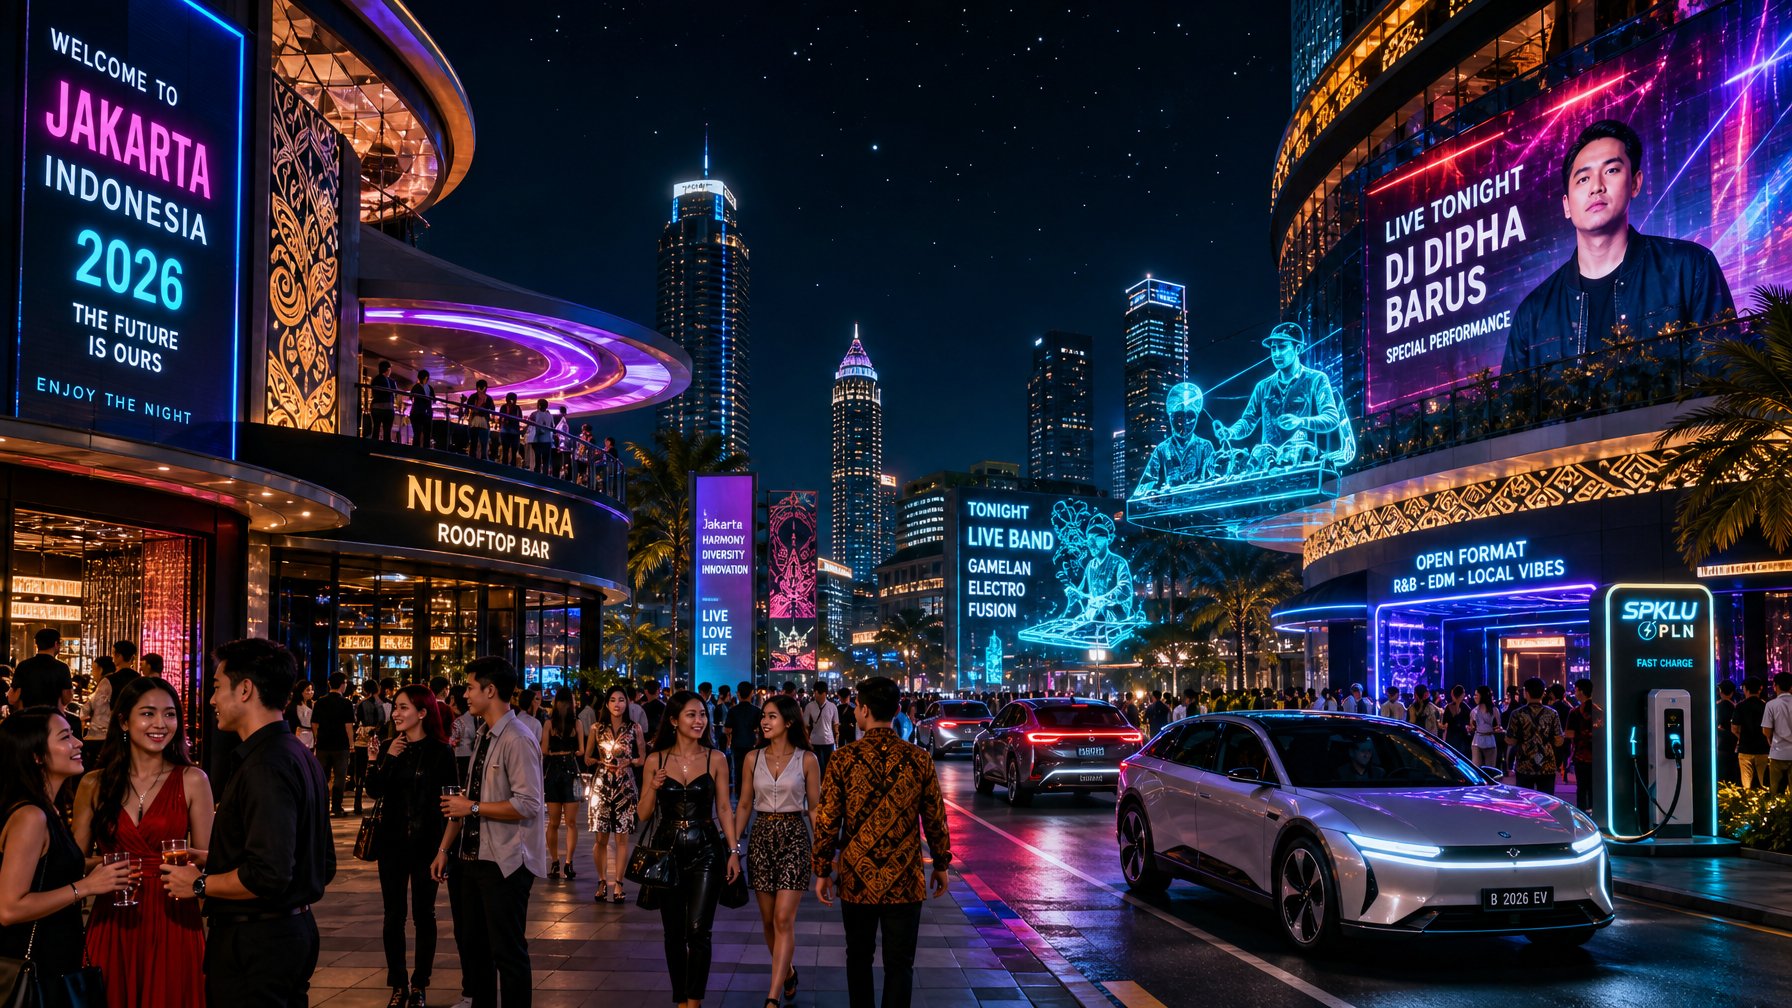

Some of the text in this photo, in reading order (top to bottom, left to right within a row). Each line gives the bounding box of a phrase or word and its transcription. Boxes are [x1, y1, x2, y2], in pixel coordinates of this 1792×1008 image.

[51, 28, 178, 106] WELCOME TO
[46, 80, 211, 200] JAKARTA
[45, 155, 208, 246] INDONESIA
[1385, 164, 1524, 243] LIVE TONIGHT
[1386, 205, 1526, 290] DJ DIPHA
[76, 229, 183, 311] 2026
[1386, 265, 1487, 334] BARUS
[73, 302, 179, 350] THE FUTURE
[1386, 310, 1511, 364] SPECIAL PERFORMANCE
[89, 335, 162, 373] IS OURS
[37, 376, 192, 425] ENJOY THE NIGHT
[407, 474, 575, 539] NUSANTARA
[968, 502, 1029, 520] TONIGHT
[702, 518, 743, 530] Jakarta
[438, 523, 550, 560] ROOFTOP BAR
[702, 535, 745, 545] HARMONY
[968, 527, 1054, 550] LIVE BAND
[702, 549, 745, 560] DIVERSITY
[1416, 541, 1527, 571] OPEN FORMAT
[702, 564, 749, 575] INNOVATION
[968, 558, 1031, 576] GAMELAN
[1394, 577, 1417, 593] R&B
[1428, 572, 1455, 589] EDM
[1468, 565, 1514, 585] LOCAL
[1519, 560, 1565, 579] VIBES
[968, 581, 1026, 597] ELECTRO
[702, 609, 728, 622] LIVE
[968, 602, 1016, 618] FUSION
[1622, 601, 1698, 620] SPKLU
[702, 626, 732, 639] LOVE
[1659, 624, 1694, 638] PLN
[702, 643, 727, 656] LIFE
[1636, 658, 1694, 668] FAST CHARGE
[1491, 891, 1548, 906] B 2026 EV
